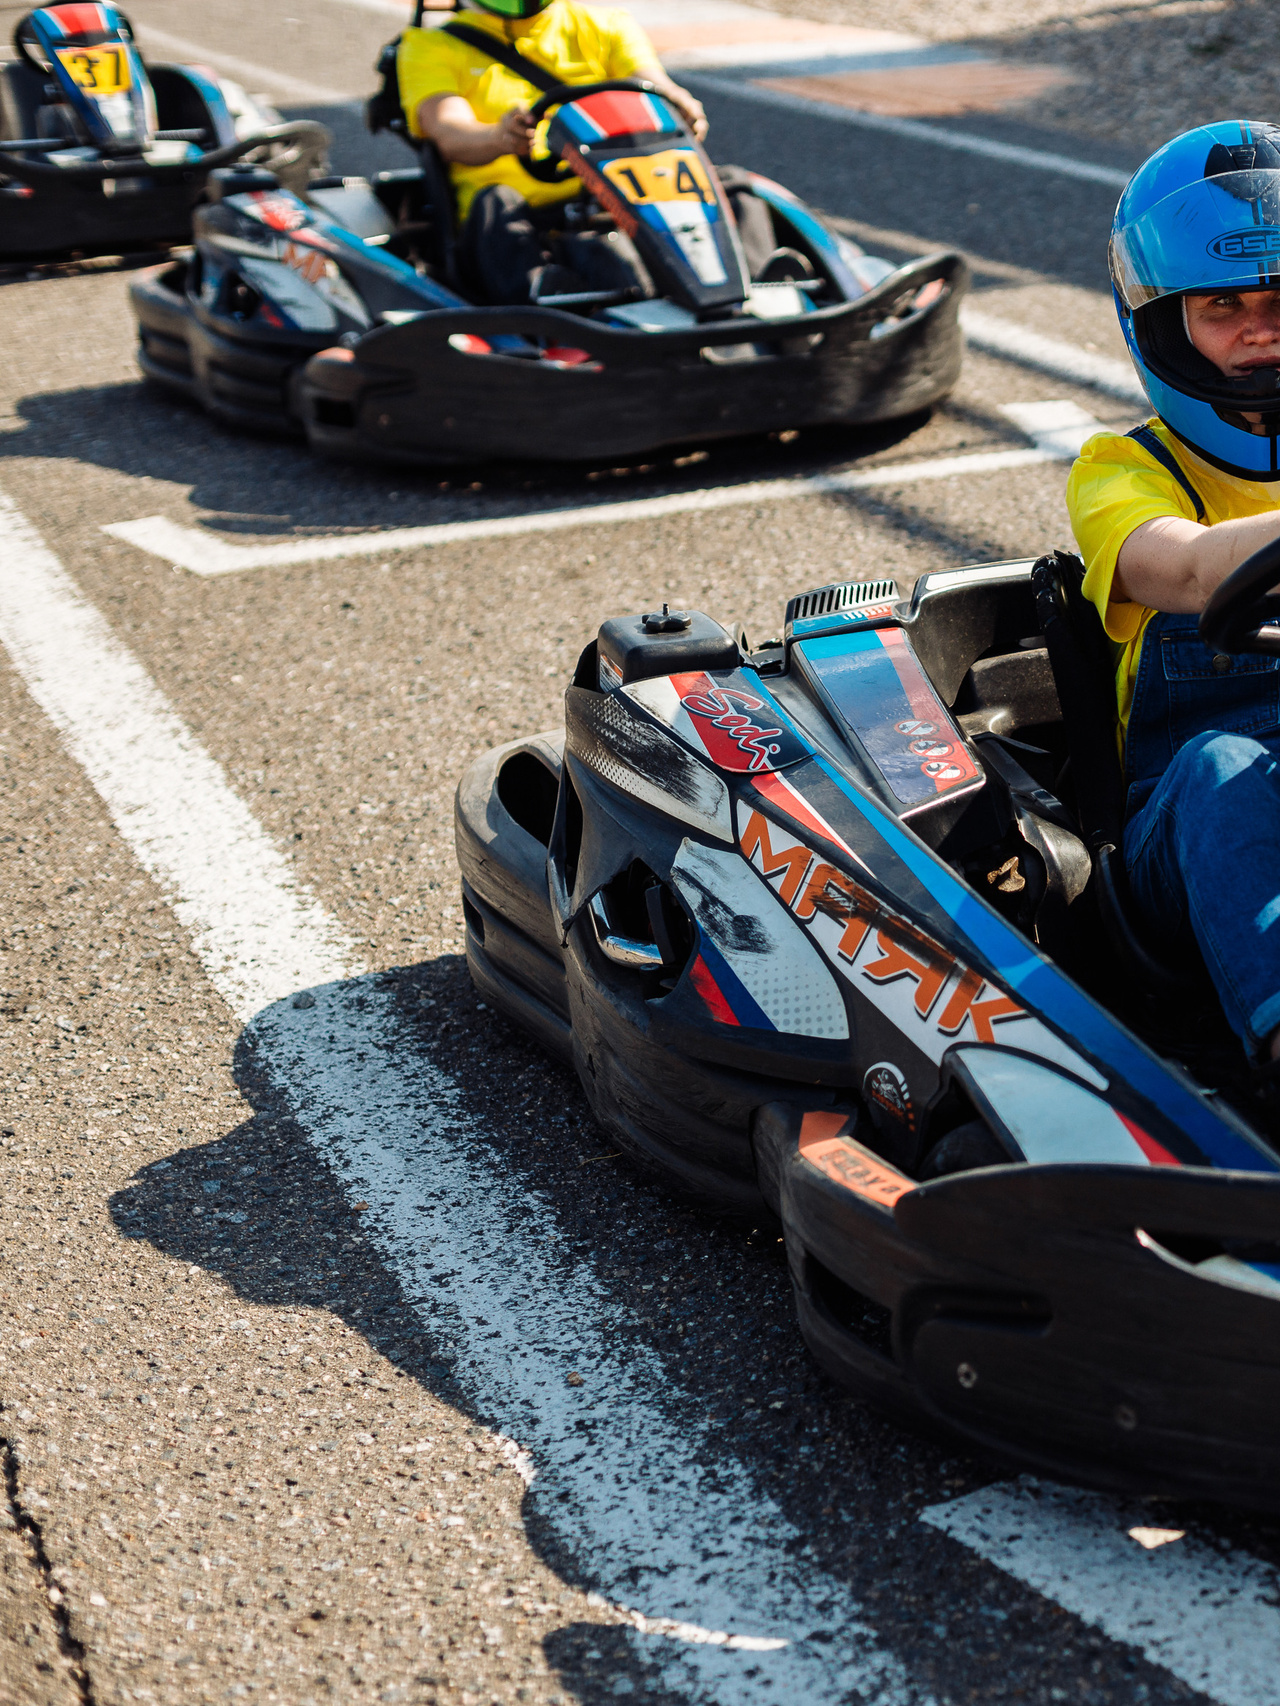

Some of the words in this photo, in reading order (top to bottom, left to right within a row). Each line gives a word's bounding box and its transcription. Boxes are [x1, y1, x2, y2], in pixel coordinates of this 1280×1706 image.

[72, 49, 121, 88] 37
[619, 160, 706, 203] 14
[680, 687, 783, 770] Sodi
